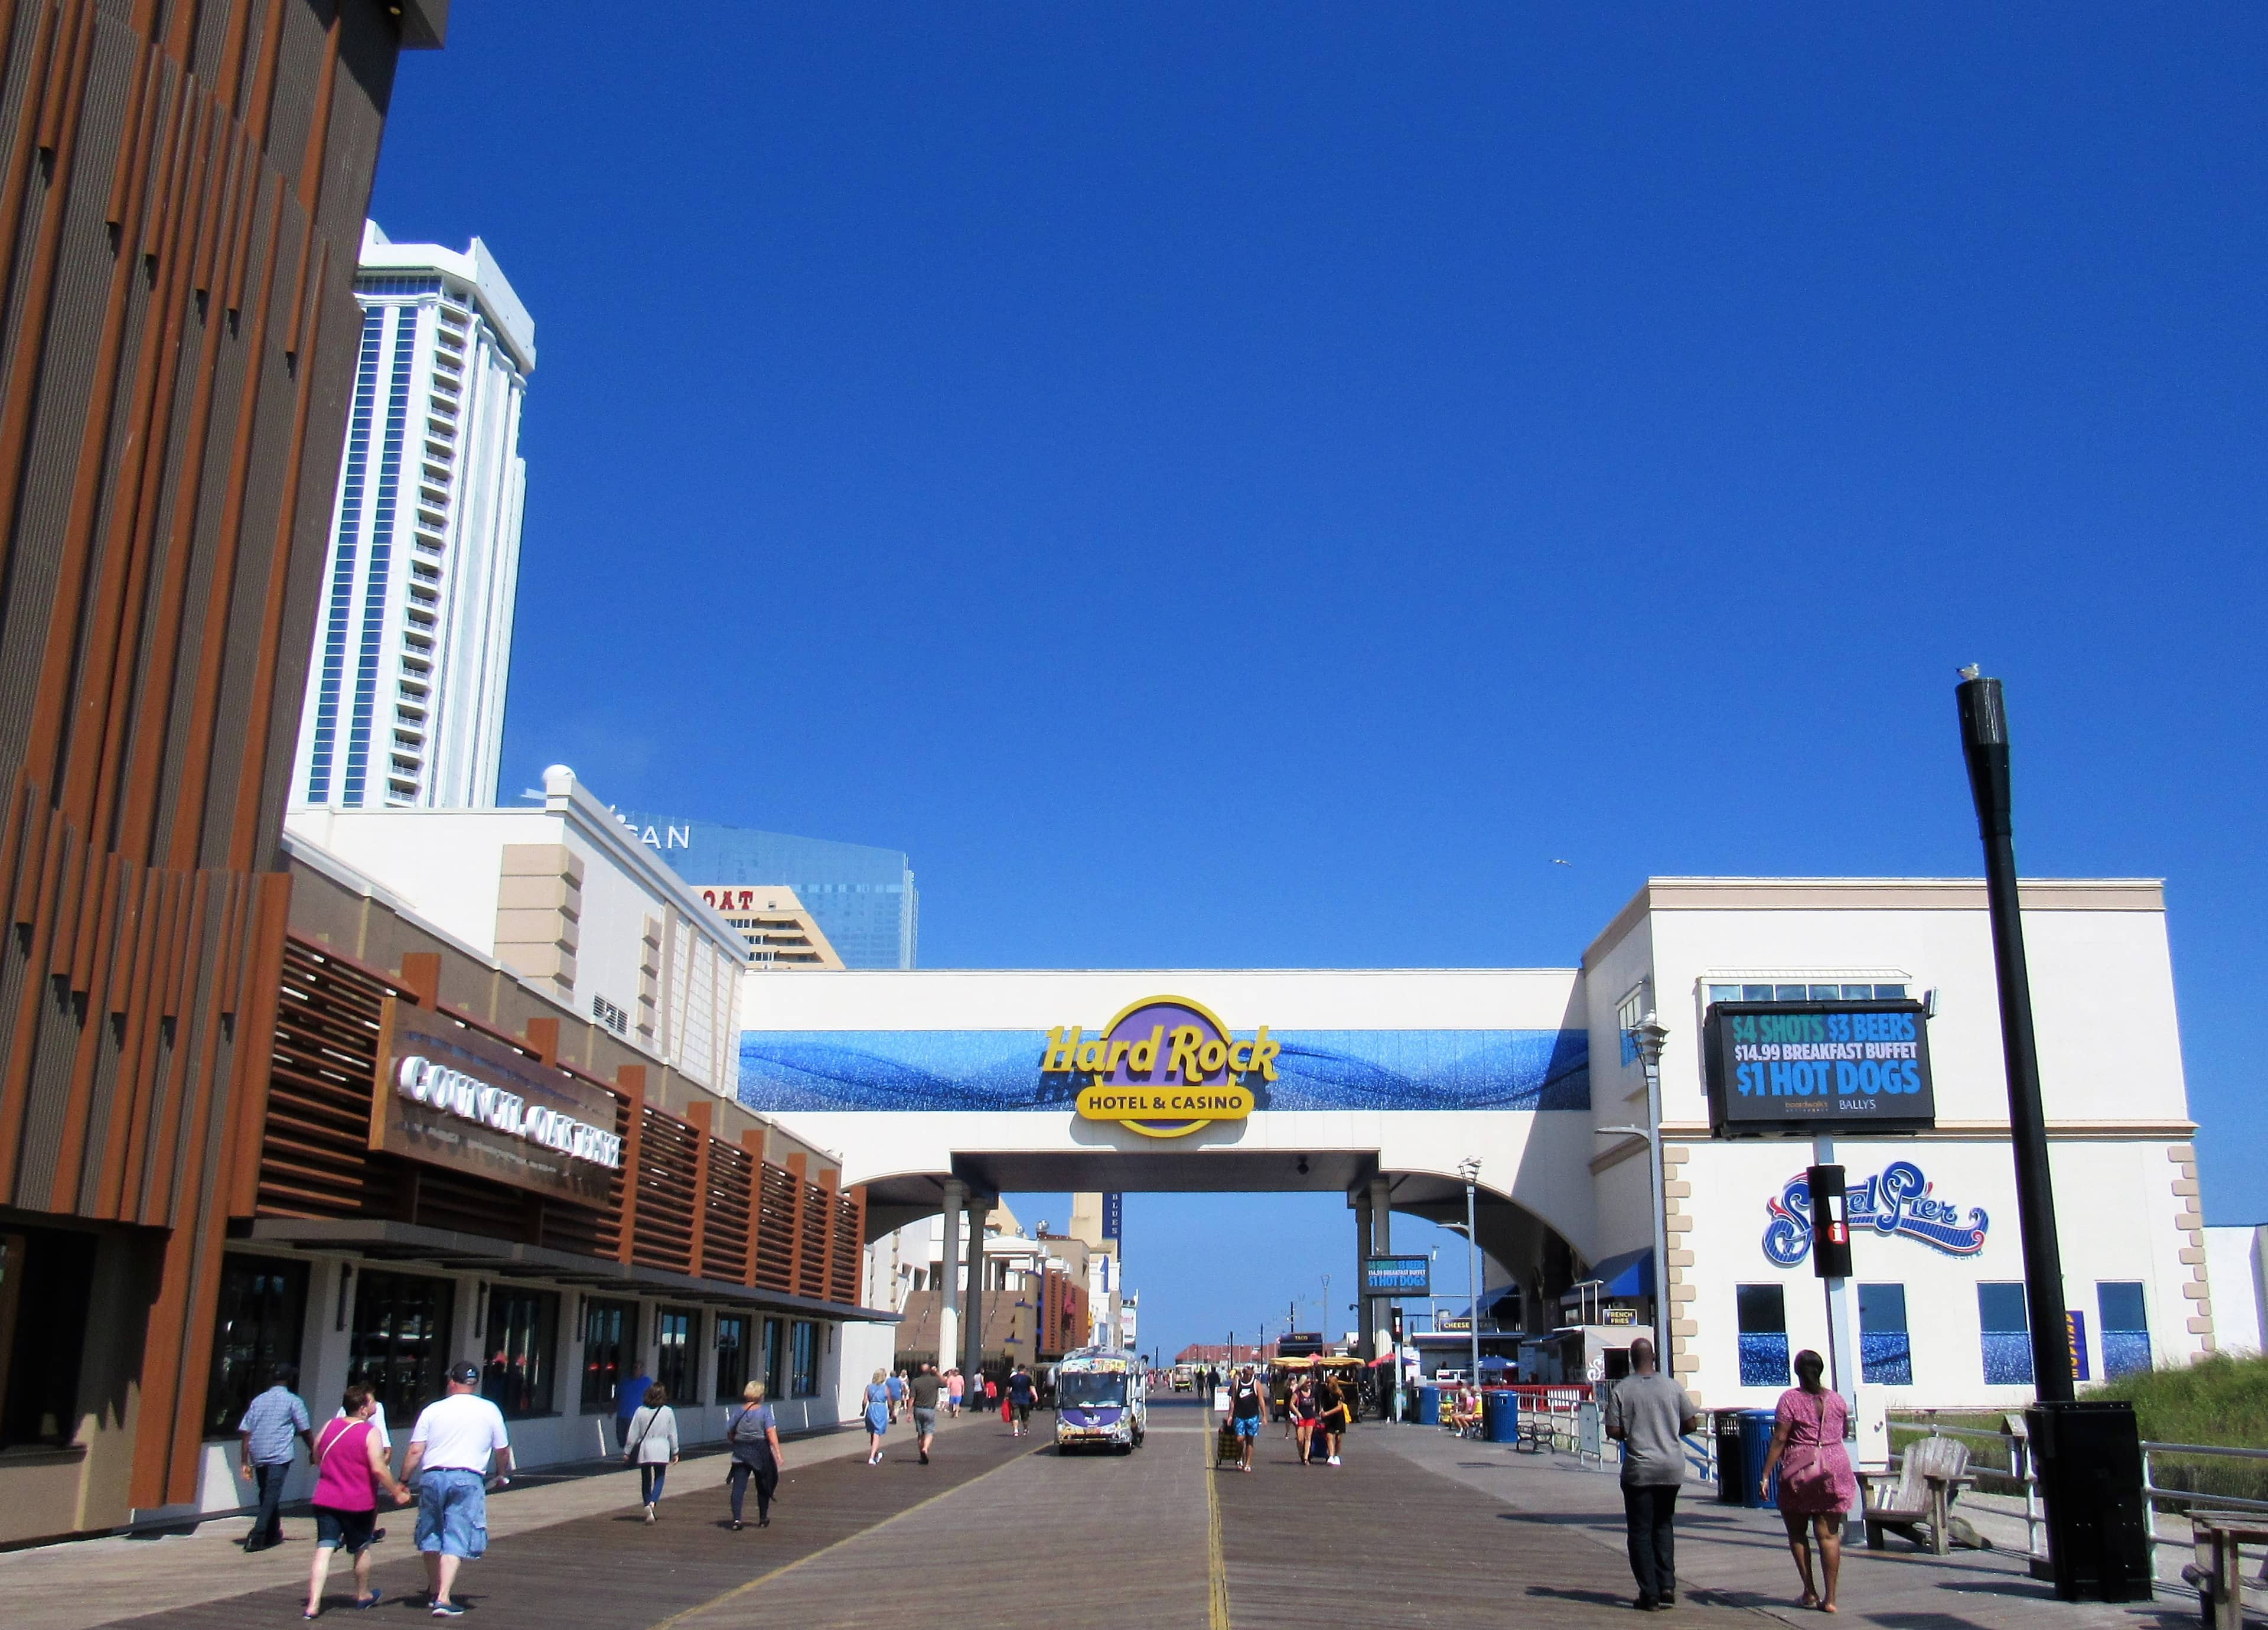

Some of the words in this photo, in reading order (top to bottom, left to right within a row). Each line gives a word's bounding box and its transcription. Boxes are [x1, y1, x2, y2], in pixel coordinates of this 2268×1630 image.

[1733, 1016, 1757, 1043] $4
[1759, 1015, 1824, 1043] SHOTS
[1827, 1014, 1850, 1042] $3
[1853, 1013, 1915, 1042] BEERS
[1042, 1025, 1165, 1073] Hard
[1168, 1025, 1281, 1082] Rock
[1735, 1044, 1780, 1061] $14.99
[1782, 1043, 1863, 1060] BREAKFAST
[1865, 1042, 1917, 1059] BUFFET
[1735, 1062, 1766, 1097] $1
[1770, 1061, 1830, 1096] HOT
[1836, 1059, 1921, 1095] DOGS
[399, 1056, 526, 1137] COUNCIL
[525, 1105, 576, 1153] OAK
[1089, 1095, 1148, 1110] HOTEL
[1152, 1095, 1166, 1110] &
[1172, 1095, 1242, 1110] CASINO
[1873, 1160, 1957, 1233] Pier
